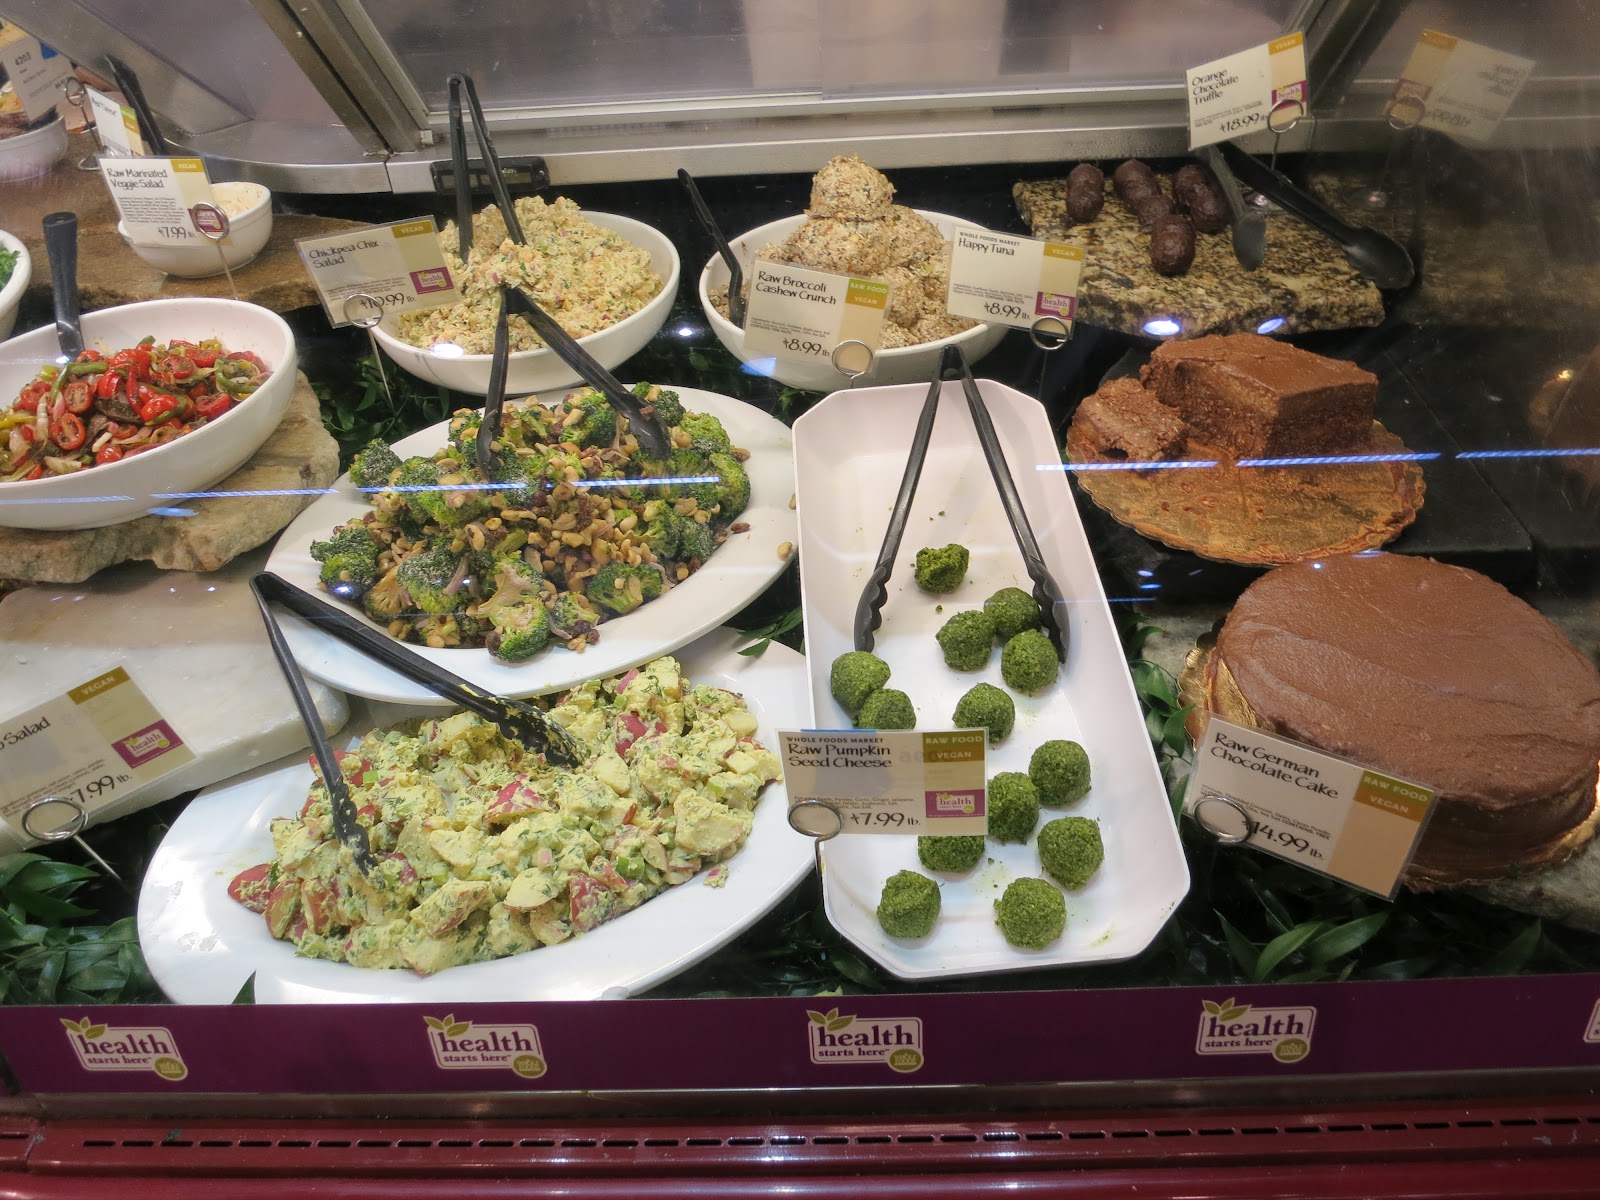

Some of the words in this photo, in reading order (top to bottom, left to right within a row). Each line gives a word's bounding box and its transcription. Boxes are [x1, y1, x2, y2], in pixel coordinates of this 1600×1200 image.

[1191, 69, 1228, 87] Orange
[1192, 76, 1239, 96] Chocolate
[1194, 90, 1223, 106] Truffle
[107, 168, 125, 178] Raw
[125, 169, 168, 178] Marinated
[111, 179, 139, 191] Veggie
[139, 180, 164, 189] Salad
[400, 225, 424, 234] VEGAN
[958, 237, 989, 254] Happy
[989, 243, 1015, 256] Tuna
[960, 231, 978, 240] WHOLE
[980, 235, 998, 243] FOODS
[999, 238, 1021, 247] MARKET
[309, 243, 356, 260] Chickpea
[356, 240, 379, 250] Chix
[1052, 248, 1075, 257] VEGAN
[312, 256, 345, 269] Salad
[758, 270, 782, 283] Raw
[782, 276, 827, 293] Broccoli
[850, 282, 865, 291] RAW
[866, 285, 888, 294] FOOD
[756, 282, 798, 298] Cashew
[798, 290, 837, 305] Crunch
[854, 296, 878, 305] VEGAN
[1044, 296, 1068, 307] health
[81, 676, 116, 695] VEGAN
[3, 716, 52, 745] Salad
[130, 733, 162, 751] health
[925, 736, 950, 745] RAW
[952, 735, 984, 744] FOOD
[788, 743, 822, 755] Raw
[825, 744, 891, 757] Pumpkin
[936, 751, 972, 759] VEGAN
[1215, 732, 1251, 753] Raw
[1252, 747, 1320, 778] German
[788, 756, 830, 767] Seed
[832, 757, 894, 768] Cheese
[116, 774, 133, 783] lb.
[1210, 747, 1293, 782] Chocolate
[1294, 776, 1339, 799] Cake
[1363, 775, 1389, 791] RAW
[1392, 783, 1428, 802] FOOD
[1370, 795, 1409, 814] VEGAN
[907, 816, 922, 826] lb.
[1309, 847, 1324, 861] lb.
[1206, 1013, 1304, 1037] health
[437, 1031, 534, 1052] health
[817, 1024, 914, 1047] health
[1204, 1039, 1240, 1047] starts
[77, 1033, 171, 1054] health
[87, 1056, 120, 1064] starts
[443, 1054, 478, 1062] starts
[818, 1048, 854, 1057] starts
